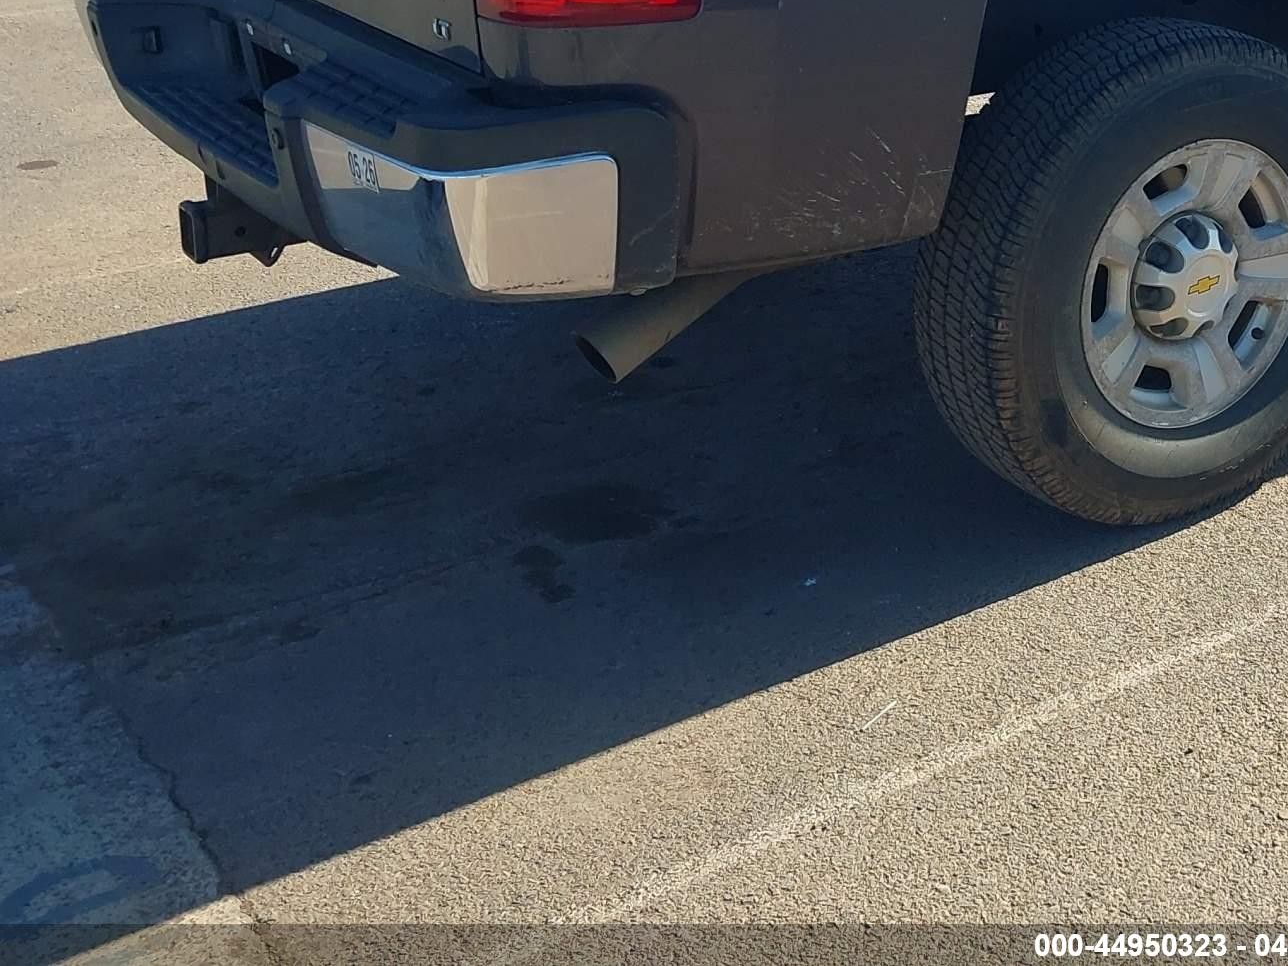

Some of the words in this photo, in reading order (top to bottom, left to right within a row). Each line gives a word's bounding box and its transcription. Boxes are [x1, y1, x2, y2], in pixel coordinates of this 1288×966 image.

[432, 18, 449, 40] LT
[348, 151, 362, 179] 05
[363, 157, 376, 186] 26
